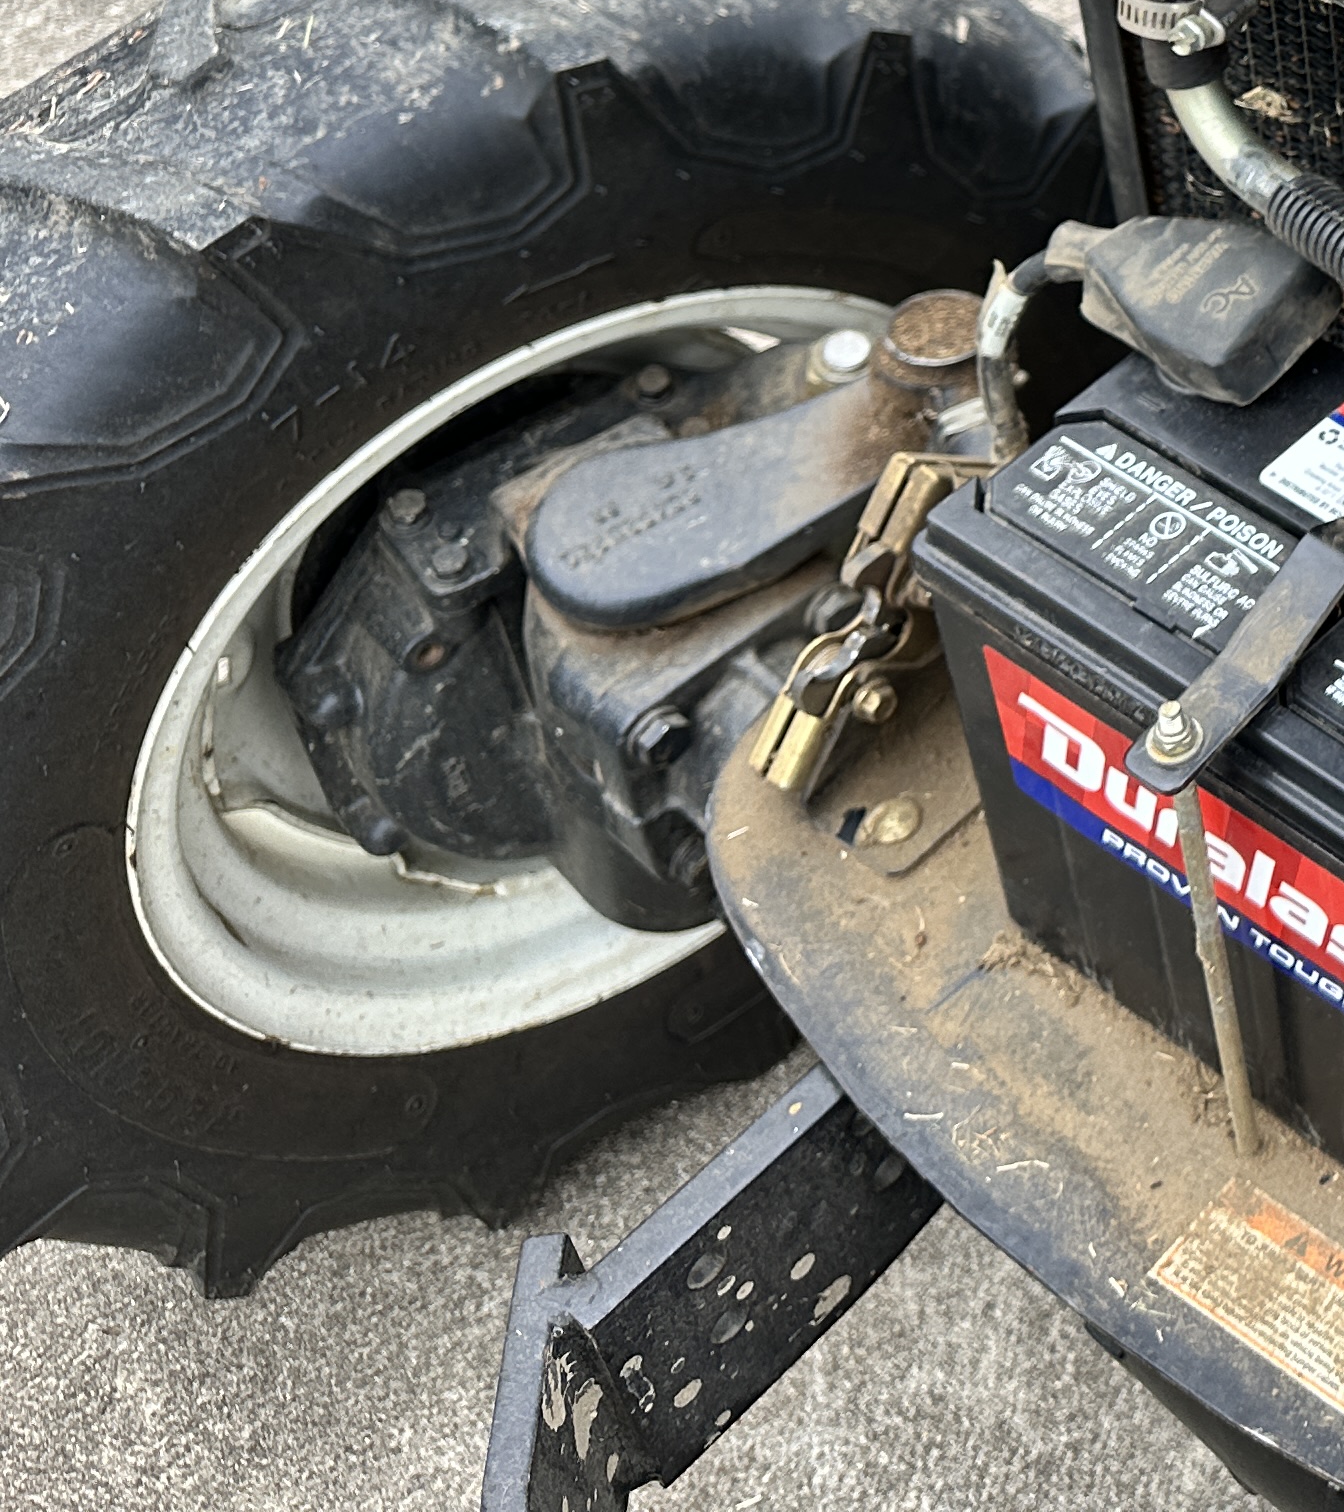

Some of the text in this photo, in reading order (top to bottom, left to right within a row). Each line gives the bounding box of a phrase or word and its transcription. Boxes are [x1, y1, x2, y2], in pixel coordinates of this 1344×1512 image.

[1116, 450, 1284, 559] DANGER / POISON
[1100, 827, 1241, 934] PROVN
